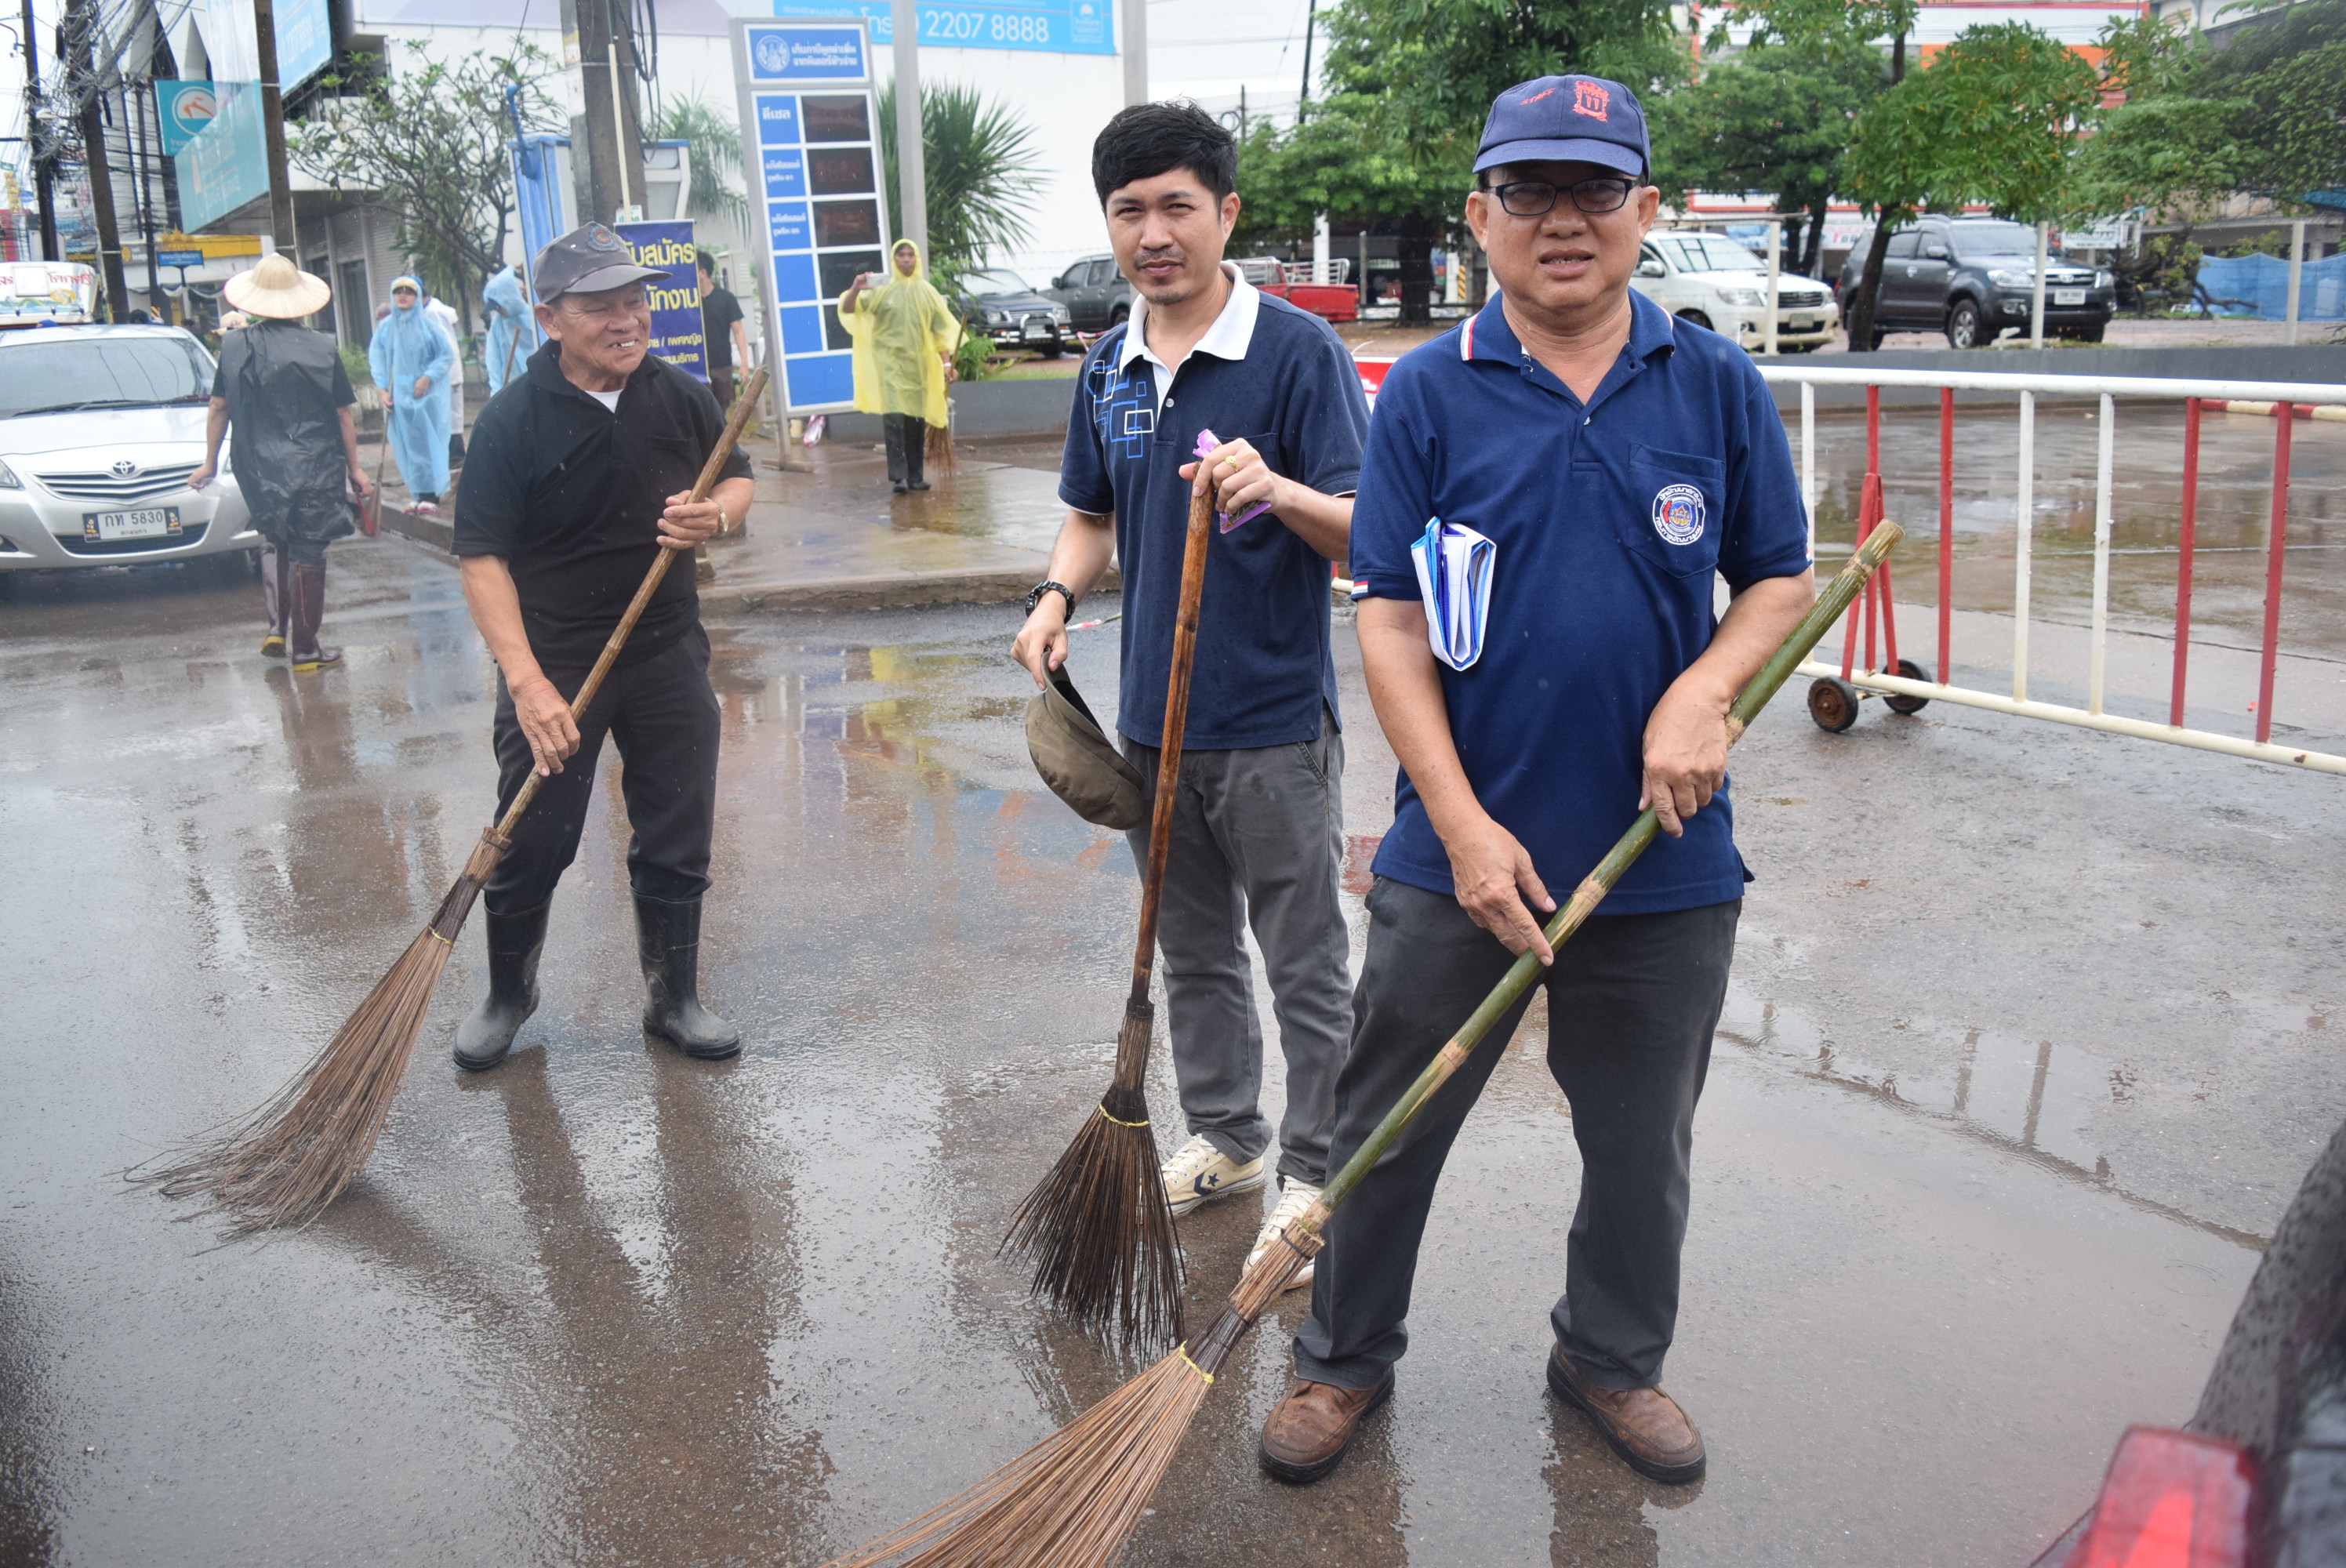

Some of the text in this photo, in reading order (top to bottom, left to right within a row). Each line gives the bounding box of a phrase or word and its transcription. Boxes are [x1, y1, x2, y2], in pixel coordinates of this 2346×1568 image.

[925, 10, 985, 38] 2207
[991, 14, 1049, 42] 8888
[1520, 88, 1556, 105] STAFF
[762, 107, 791, 120] ดีเซล
[622, 238, 695, 267] ับสมัคร
[645, 285, 699, 311] ักงาน
[130, 510, 163, 525] 5830
